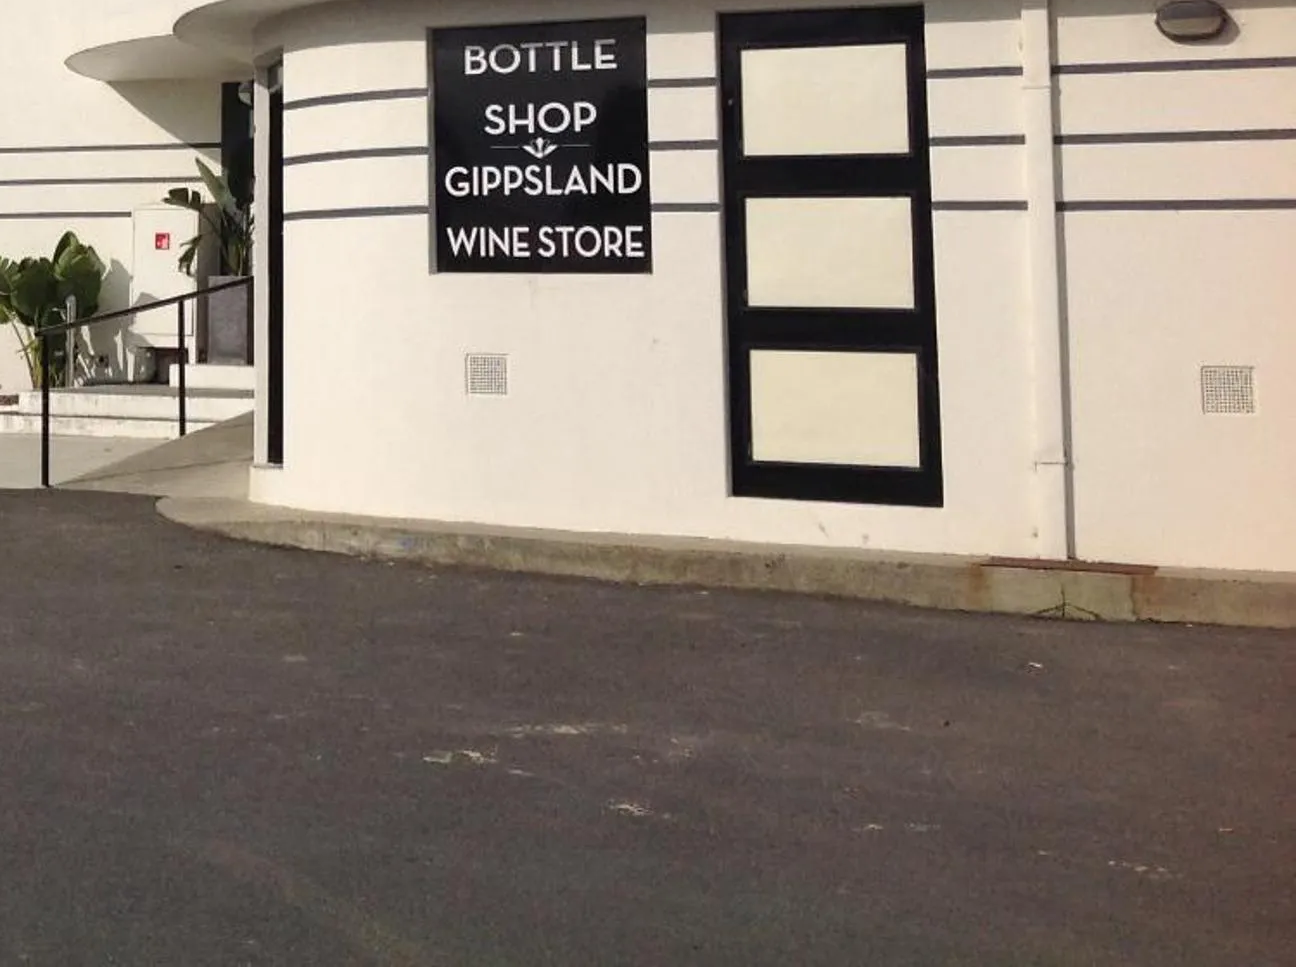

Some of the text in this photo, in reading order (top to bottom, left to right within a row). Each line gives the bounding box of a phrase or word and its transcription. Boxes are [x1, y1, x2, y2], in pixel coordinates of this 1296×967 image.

[463, 38, 618, 75] BOTTLE
[484, 101, 597, 135] SHOP
[444, 163, 643, 197] GIPPSLAND
[446, 225, 645, 258] WINE STORE
